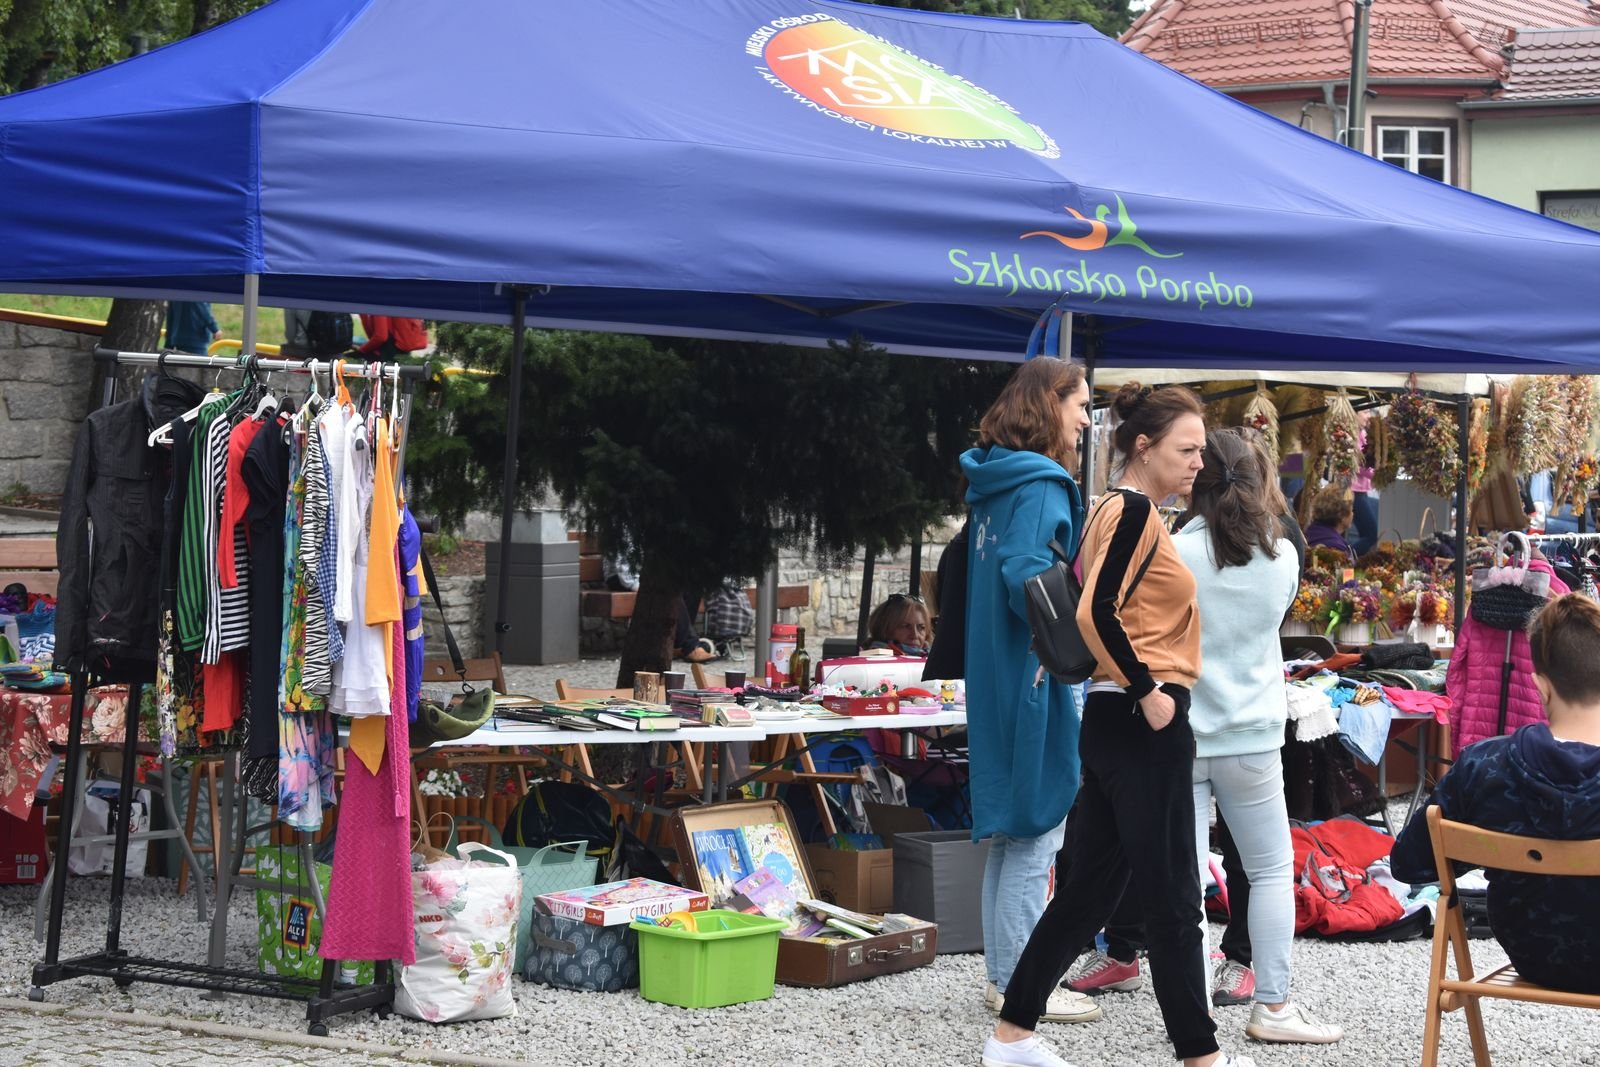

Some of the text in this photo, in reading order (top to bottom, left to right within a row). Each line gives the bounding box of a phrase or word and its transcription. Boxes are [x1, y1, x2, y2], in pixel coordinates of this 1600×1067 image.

[745, 26, 778, 57] MIEJSKI
[757, 70, 875, 131] AKTYWNOŚCI
[882, 127, 985, 148] LOKALNEJ
[985, 139, 1008, 149] W
[948, 248, 1254, 311] Szklarska Poręba
[288, 925, 305, 937] ALDI
[418, 914, 443, 923] NKD
